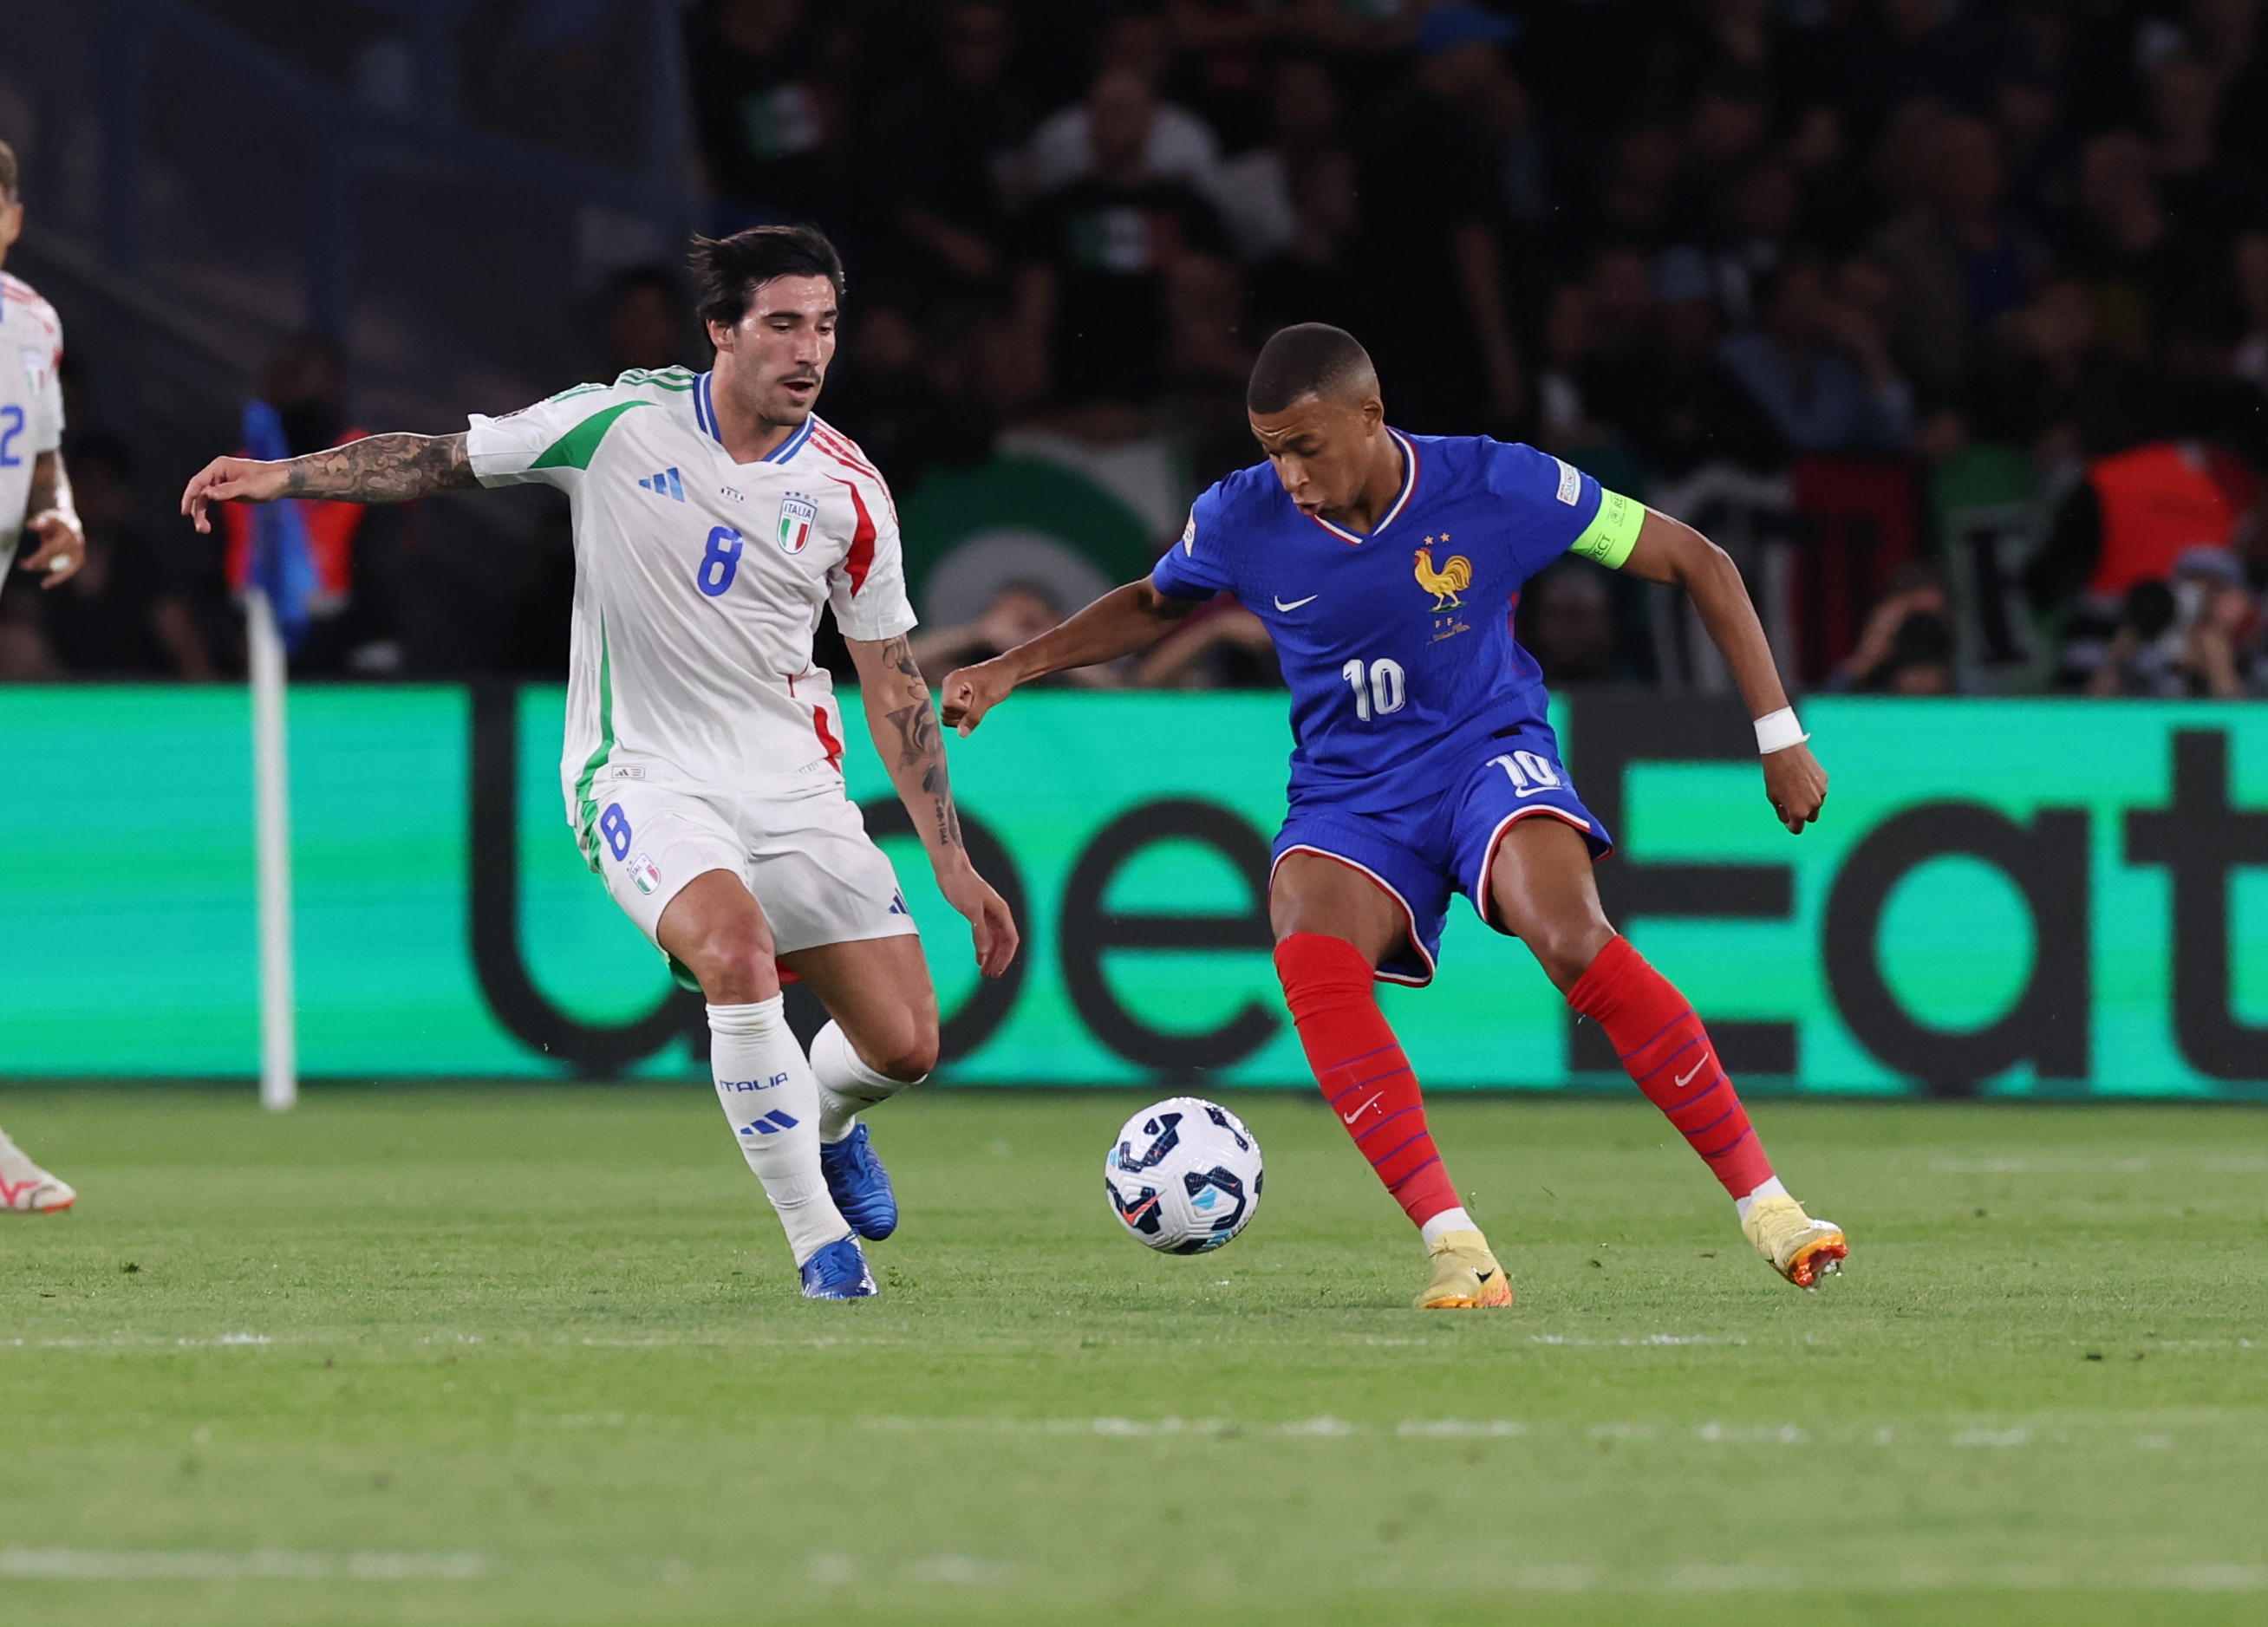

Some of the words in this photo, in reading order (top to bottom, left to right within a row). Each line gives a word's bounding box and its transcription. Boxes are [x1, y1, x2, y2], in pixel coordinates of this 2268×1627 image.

[784, 503, 811, 519] ITALIA
[697, 526, 743, 596] 8
[1343, 658, 1405, 722] 10
[1486, 751, 1561, 787] 10
[600, 803, 632, 862] 8
[720, 1072, 788, 1092] ITALIA
